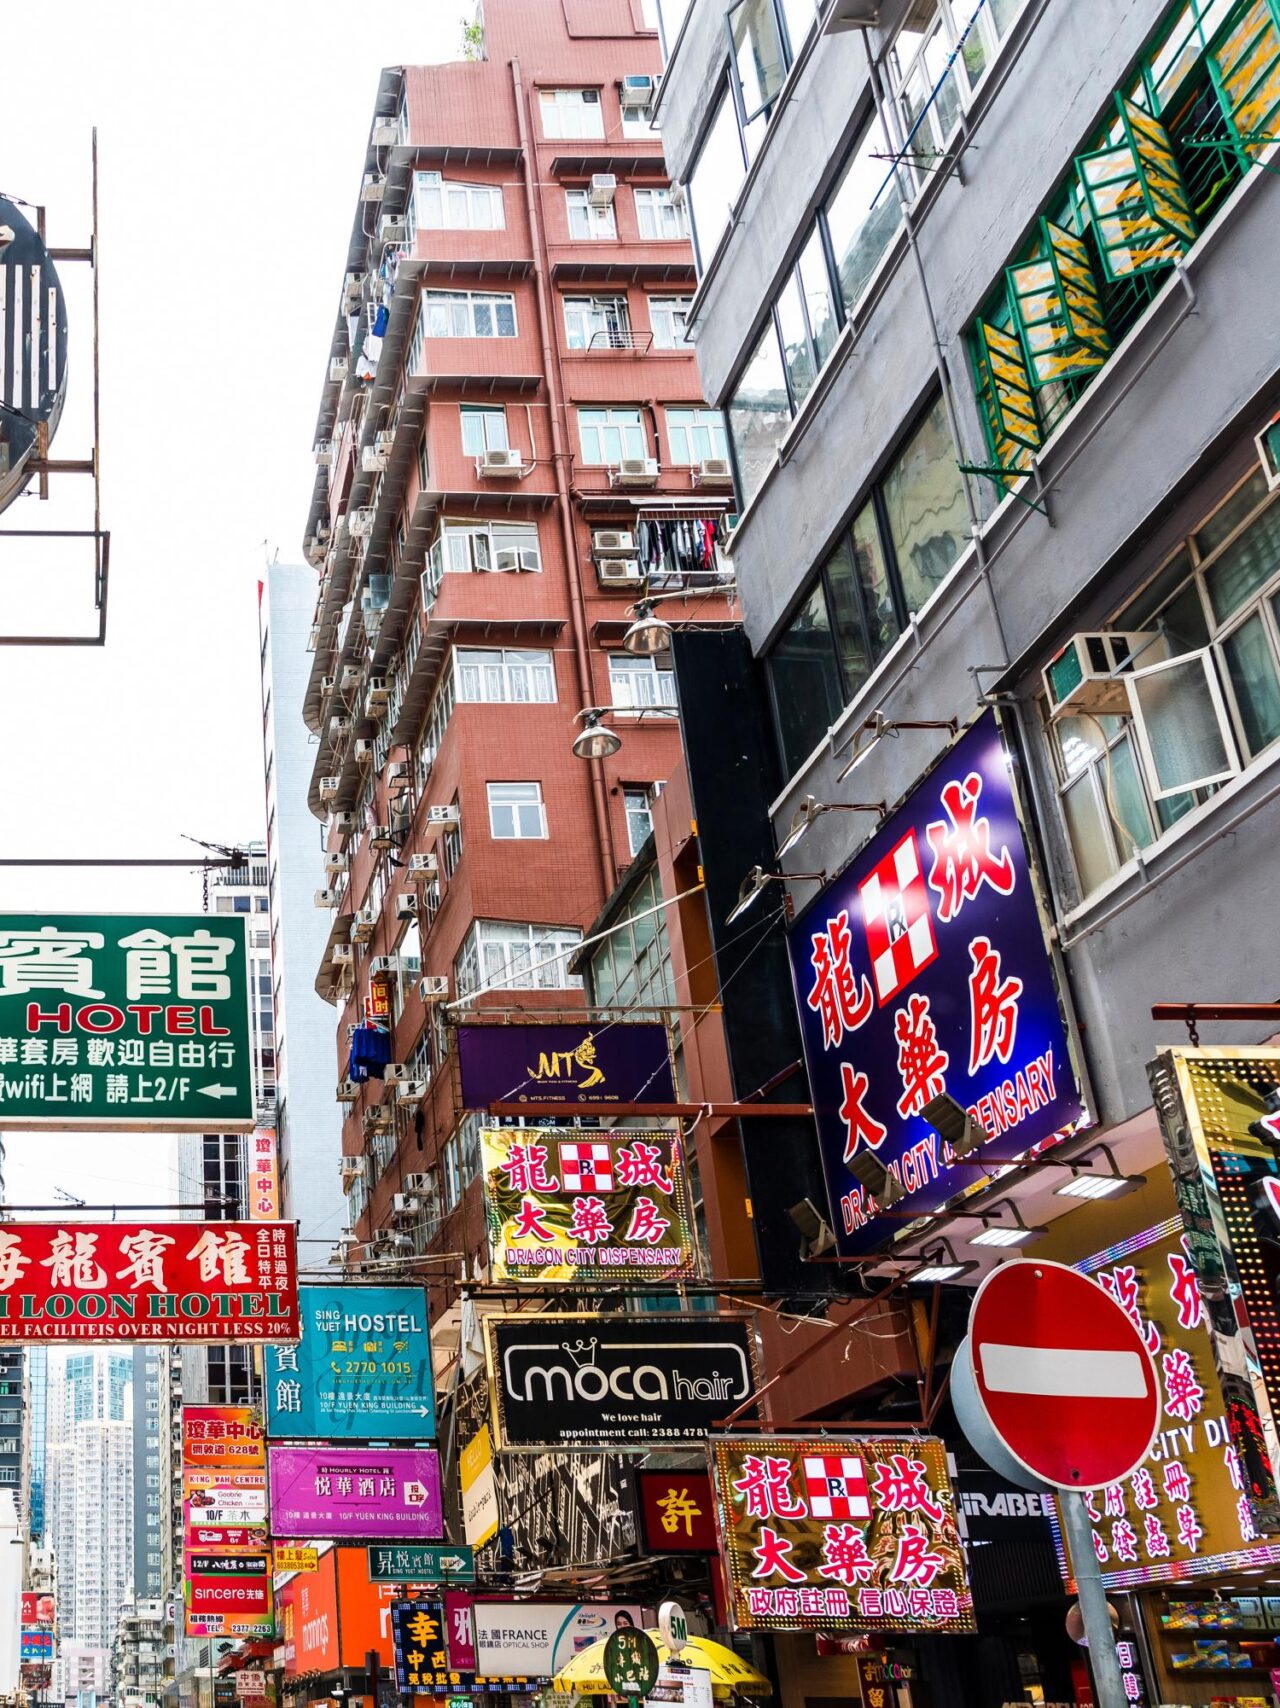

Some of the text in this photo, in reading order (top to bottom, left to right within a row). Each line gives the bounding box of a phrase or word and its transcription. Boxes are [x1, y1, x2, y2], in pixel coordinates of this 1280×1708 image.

[808, 772, 1015, 1051] 龍 城
[25, 1001, 231, 1036] HOTEL
[86, 1038, 237, 1069] 歡迎自由行
[106, 1073, 190, 1104] 請上2/F
[499, 1141, 674, 1195] 龍 城
[901, 1133, 939, 1194] CITY
[513, 1197, 670, 1244] 大藥房
[507, 1248, 681, 1265] DRAGON CITY DISPENSARY
[19, 1294, 136, 1318] LOON
[147, 1293, 291, 1318] HOTEL
[315, 1310, 341, 1320] SING
[24, 1324, 114, 1336] FACILITEIS
[118, 1323, 163, 1336] OVER
[167, 1323, 221, 1336] NIGHT
[224, 1323, 263, 1335] LESS
[267, 1323, 291, 1335] 20%
[315, 1314, 422, 1332] YUET HOSTEL
[345, 1362, 411, 1373] 2770 1015
[673, 1371, 734, 1401] hair
[601, 1412, 662, 1422] We love hair
[559, 1427, 709, 1438] appointment call: 2388 4781
[189, 1475, 210, 1483] KING
[215, 1475, 230, 1483] WAH
[735, 1454, 945, 1523] 龍 城
[206, 1510, 223, 1520] 10/F
[356, 1512, 374, 1520] YUEN
[396, 1513, 429, 1521] BUILDING
[750, 1524, 946, 1586] 大藥房
[195, 1588, 246, 1600] sincere
[749, 1587, 959, 1618] 政府註冊 信心保證
[503, 1629, 547, 1640] FRANCE
[670, 1616, 686, 1640] 5M
